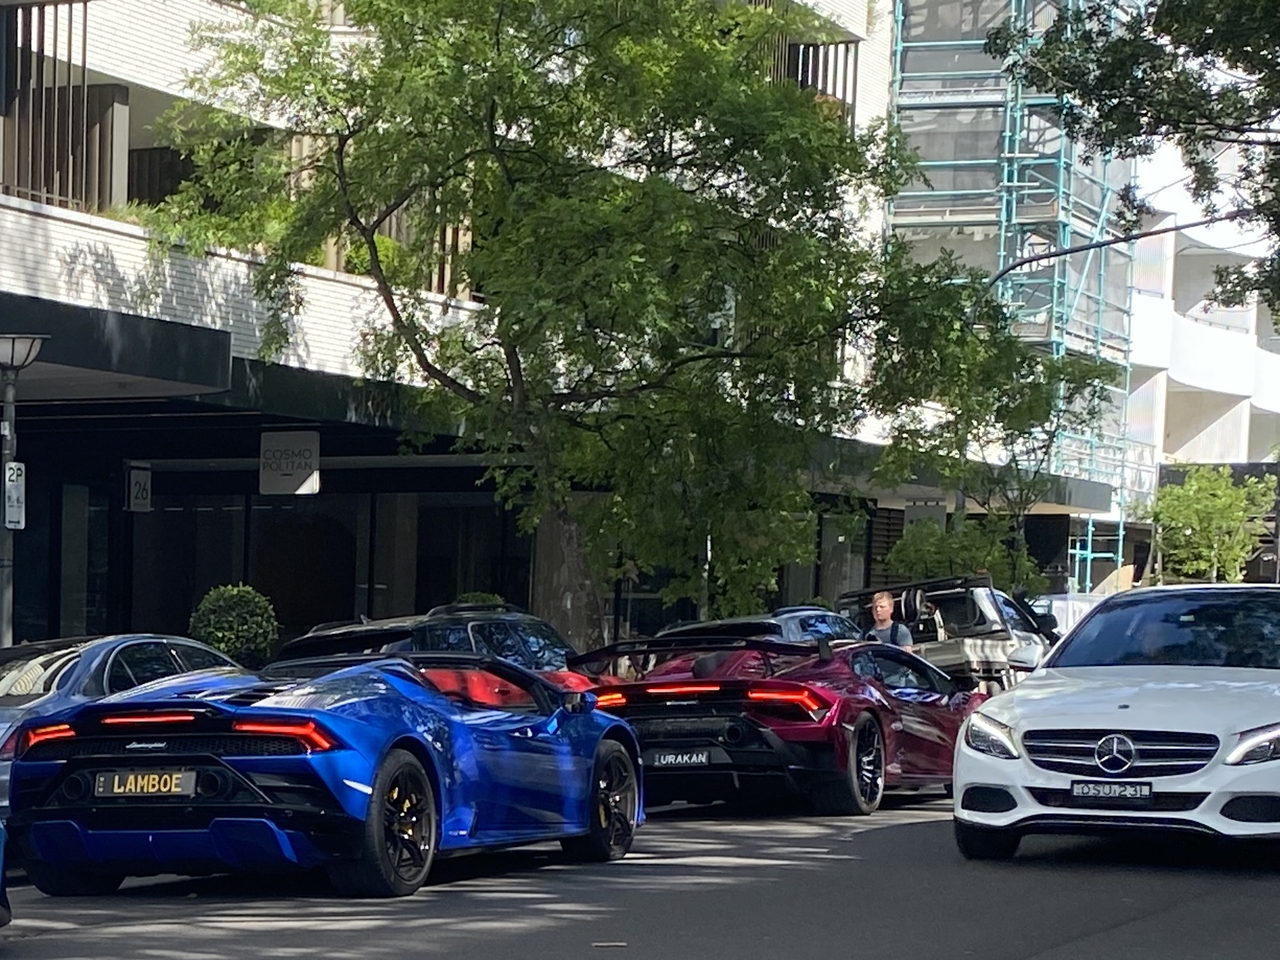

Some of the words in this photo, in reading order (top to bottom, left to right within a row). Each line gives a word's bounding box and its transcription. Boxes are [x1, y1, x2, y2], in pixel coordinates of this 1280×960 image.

[263, 448, 313, 461] COSMO
[262, 460, 313, 472] POLITAN
[8, 467, 23, 483] 2P
[134, 480, 148, 500] 26
[660, 752, 706, 764] URAKAN
[113, 774, 183, 793] LAMBOE
